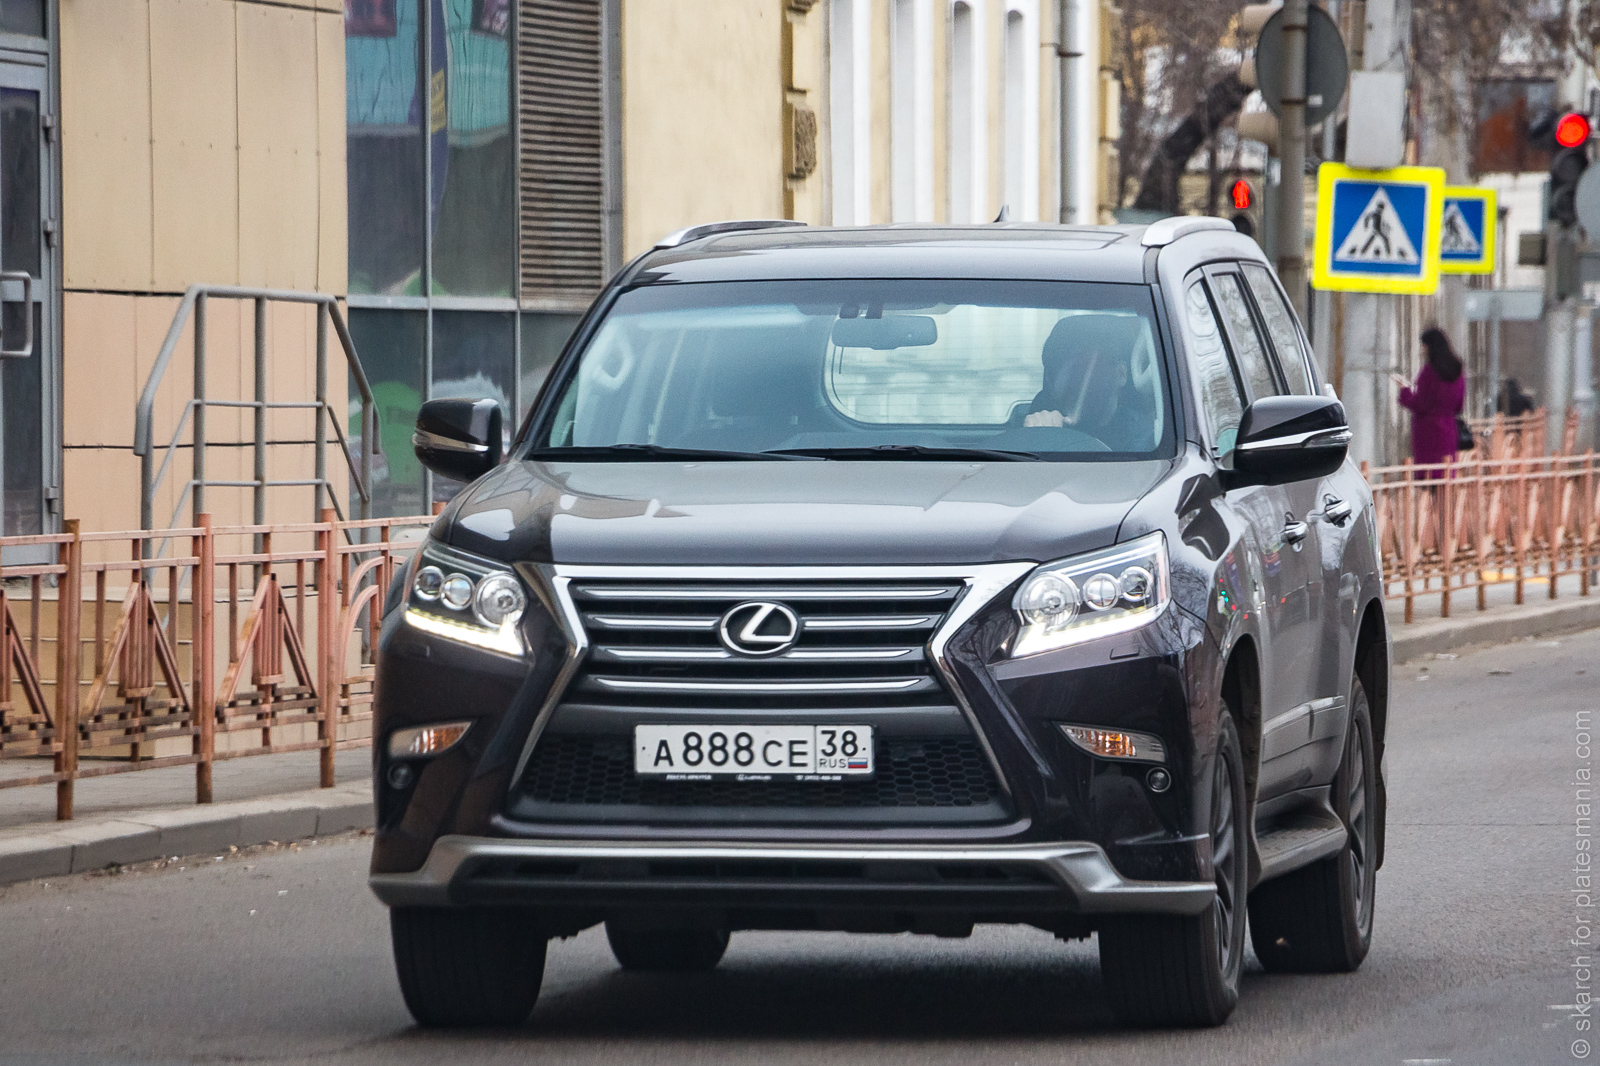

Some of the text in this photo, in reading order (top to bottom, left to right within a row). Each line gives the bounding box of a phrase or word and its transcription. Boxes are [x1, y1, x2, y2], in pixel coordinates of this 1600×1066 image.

[653, 731, 808, 767] A888CE
[820, 730, 858, 757] 38
[818, 757, 847, 769] RUS
